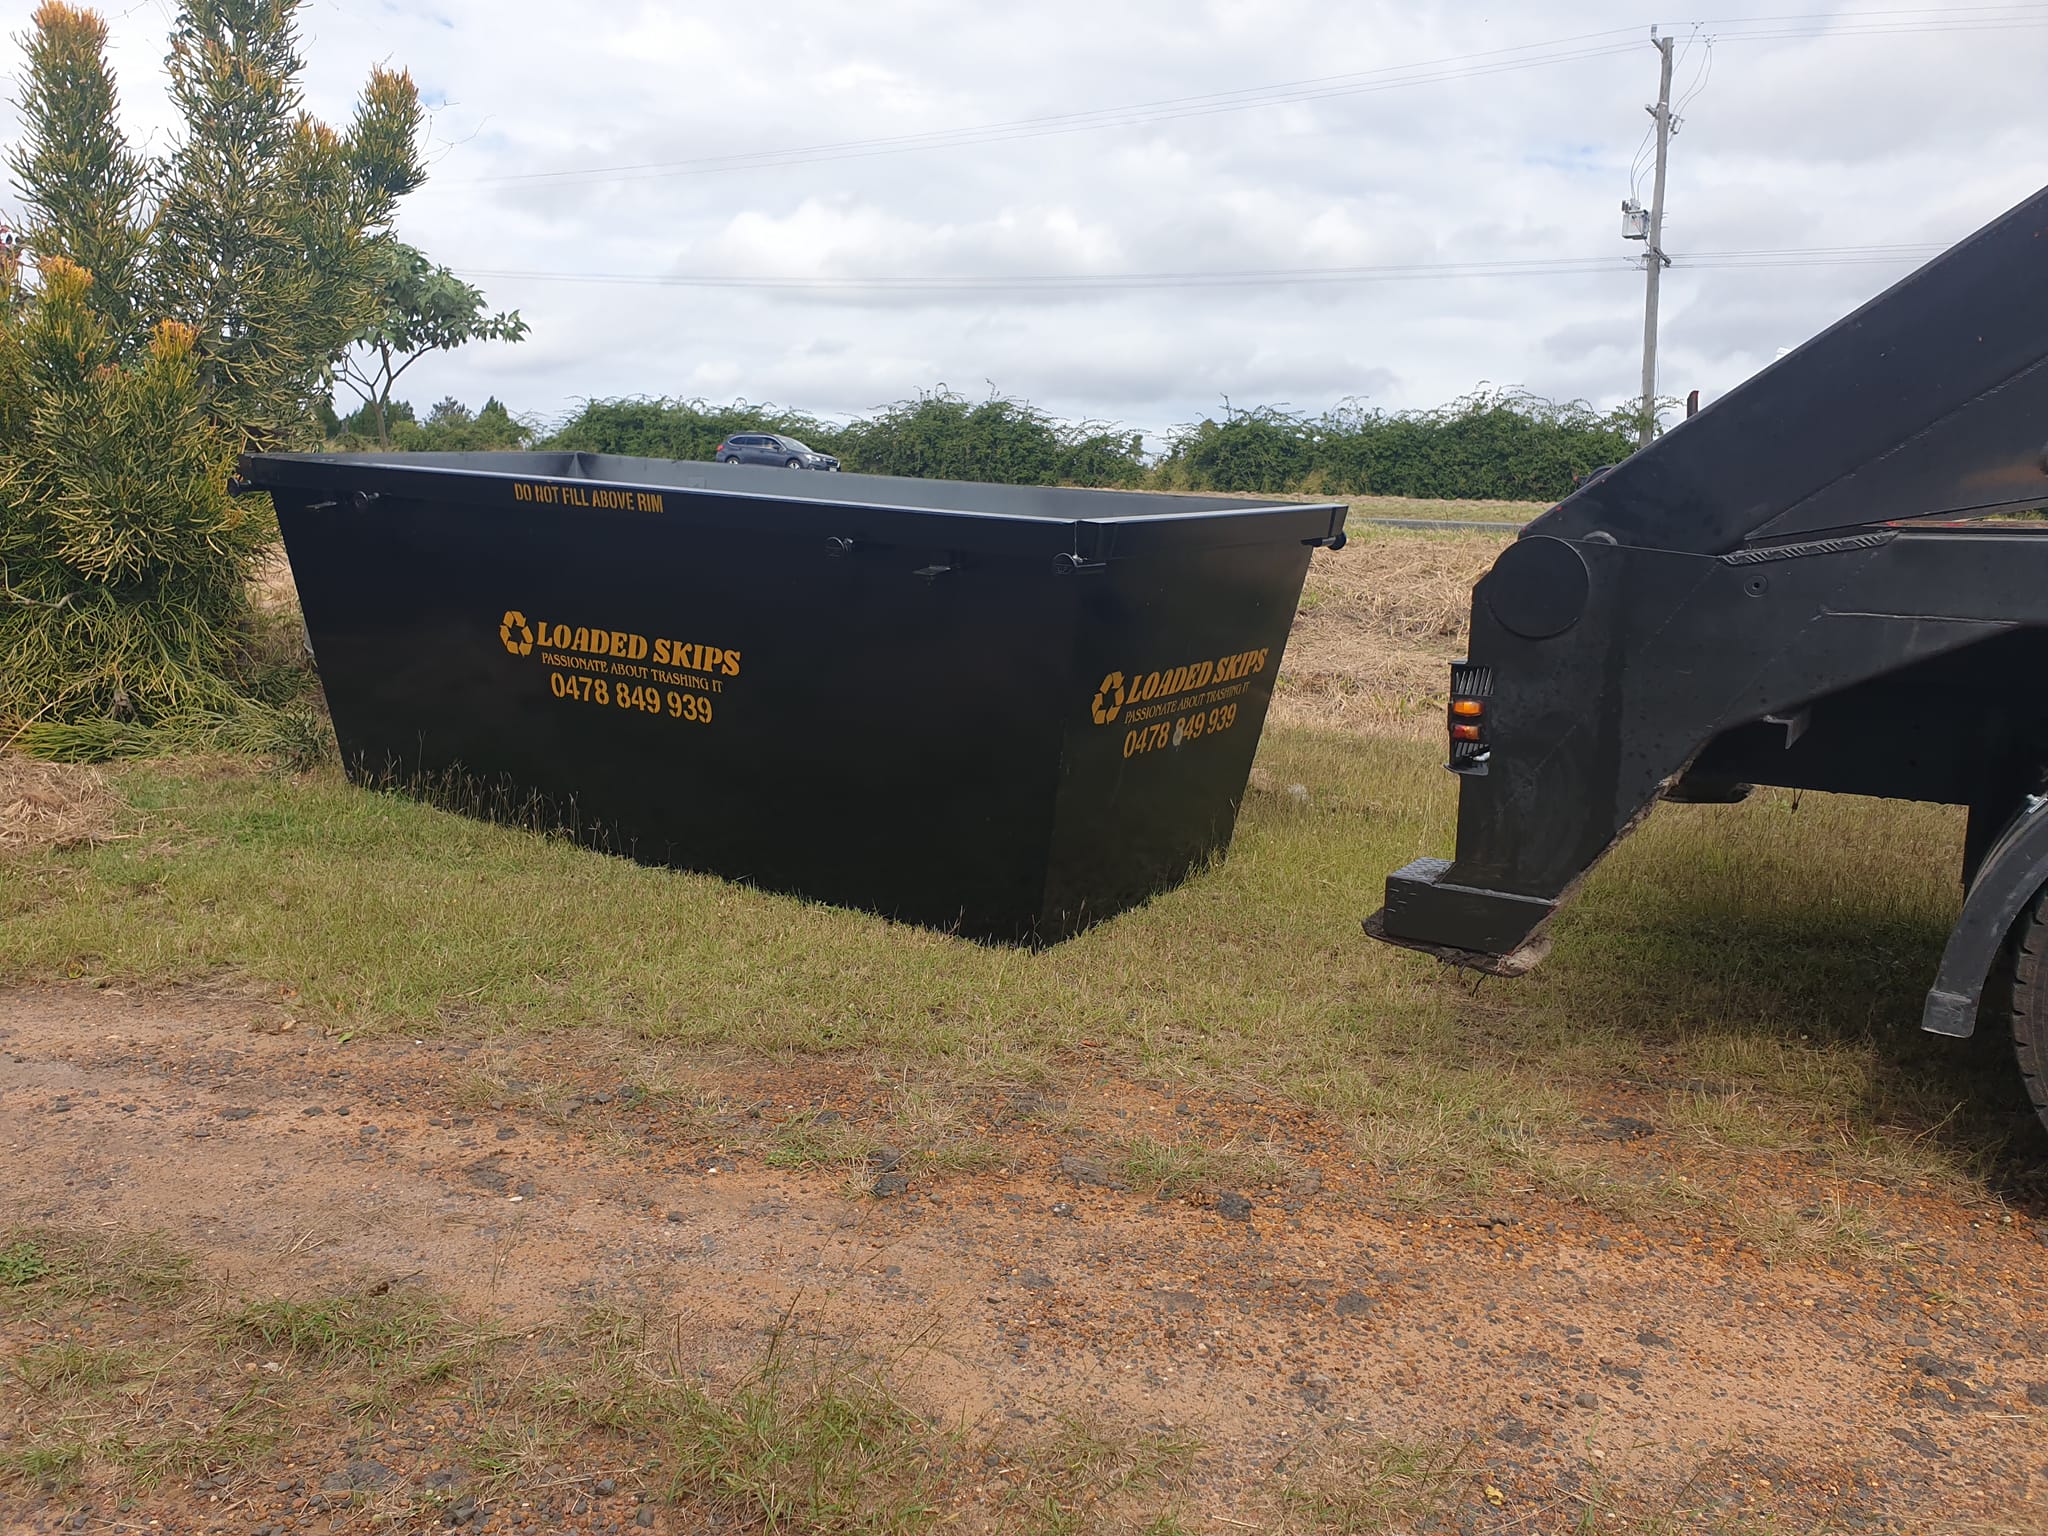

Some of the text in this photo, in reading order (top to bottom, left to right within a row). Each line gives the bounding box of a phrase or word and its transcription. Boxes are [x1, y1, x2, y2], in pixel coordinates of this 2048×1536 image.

[514, 483, 664, 513] DO NOT FILL ABOVE RIM
[537, 621, 741, 676] LOADED SKIPS
[541, 653, 723, 693] PASSIONATE ABOUT TRASHING IT
[551, 672, 713, 724] 0478 849 939
[1124, 681, 1250, 724] PASSIONATE ABOUT TRASHING IT
[1126, 648, 1269, 705] LOADED SKIPS
[1123, 703, 1237, 759] 0478 849 939
